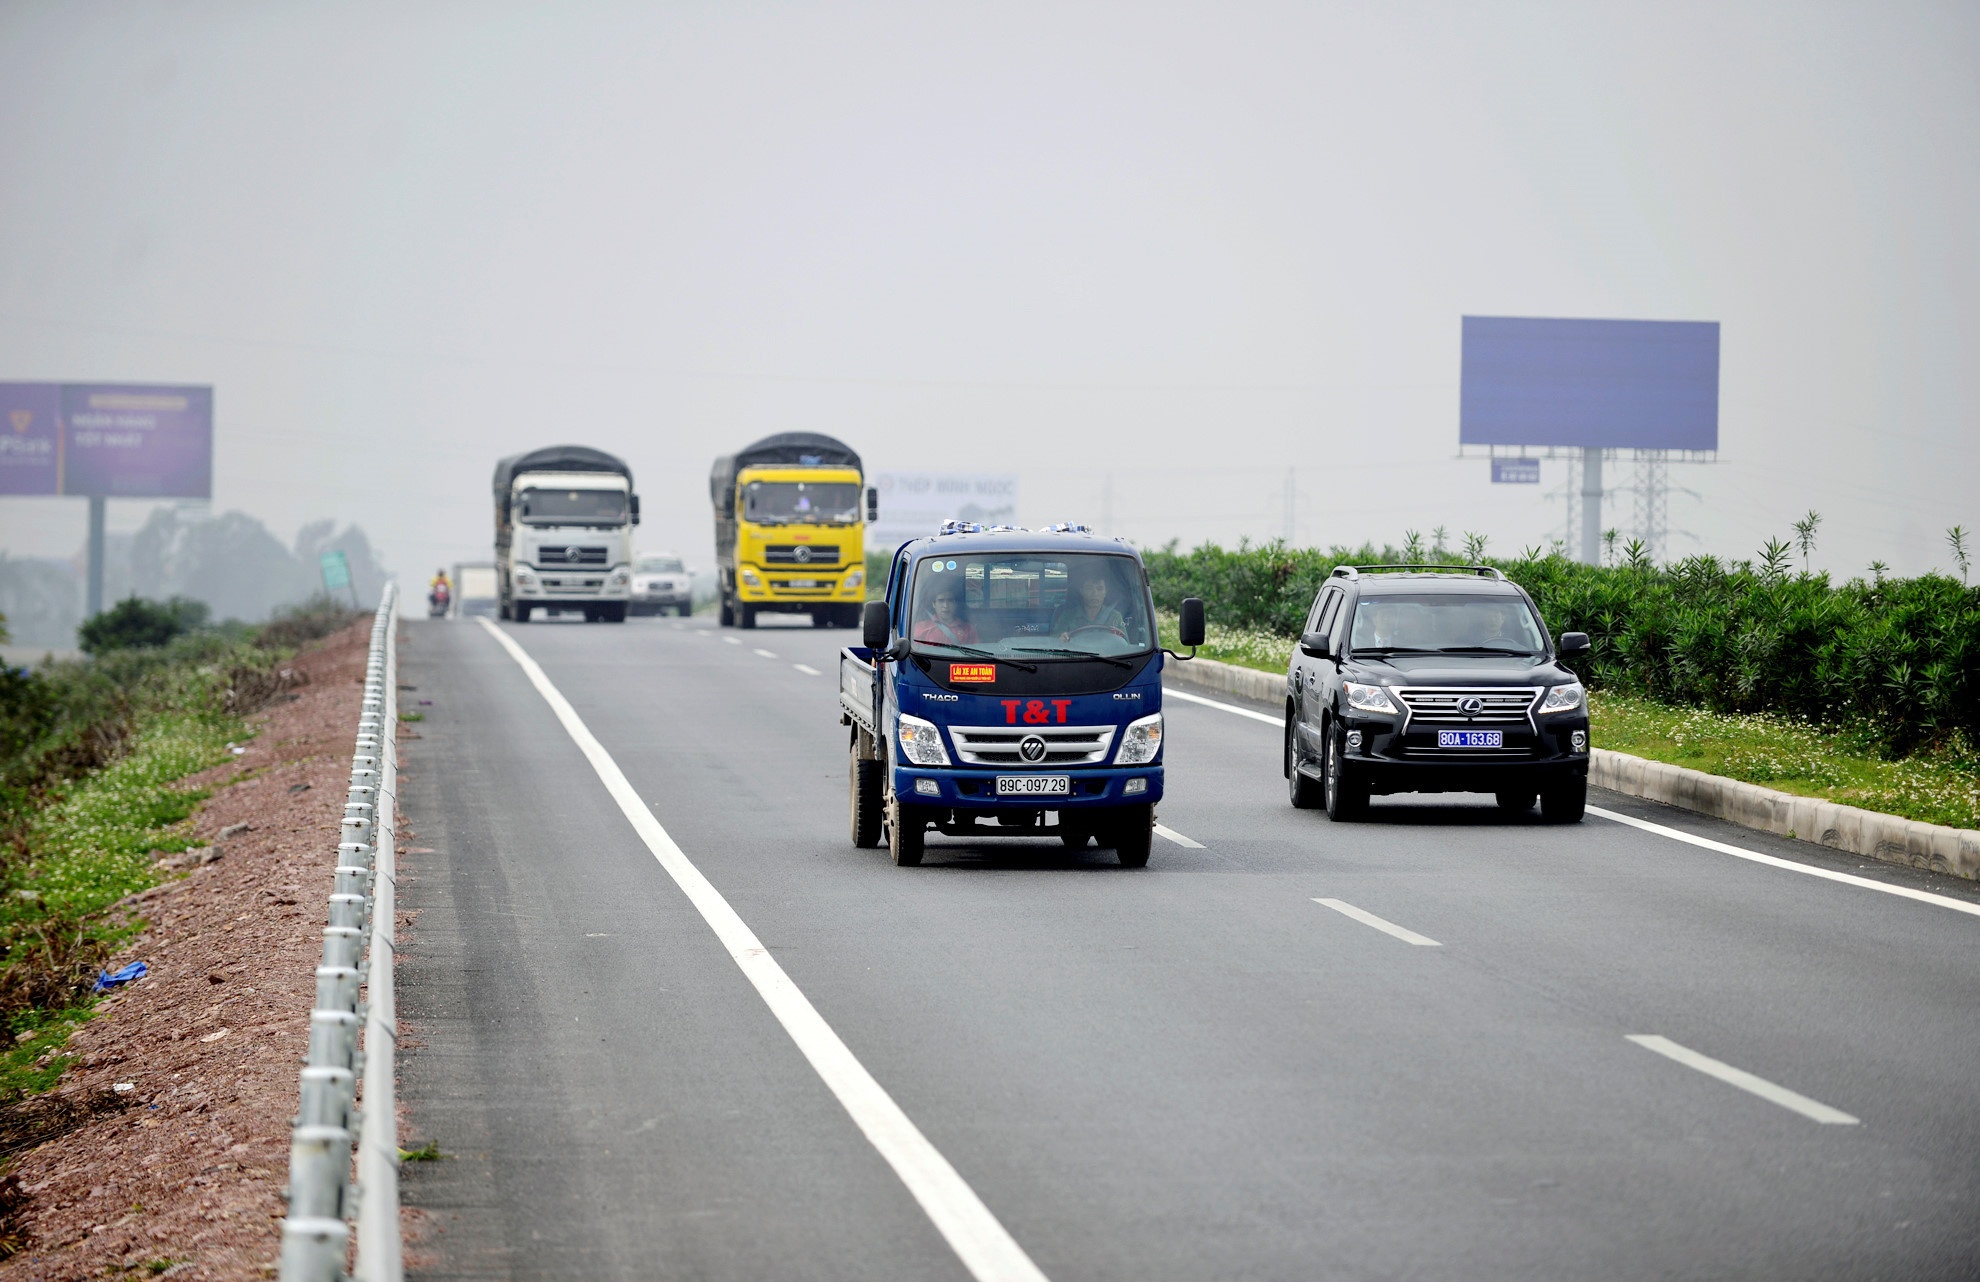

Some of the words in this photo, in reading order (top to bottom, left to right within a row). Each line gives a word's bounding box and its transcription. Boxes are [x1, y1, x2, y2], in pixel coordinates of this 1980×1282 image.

[953, 666, 962, 675] LÁI
[963, 667, 970, 675] XE
[970, 667, 978, 675] AN
[979, 666, 992, 675] TOÀN
[922, 693, 959, 702] THACO
[1112, 693, 1141, 701] OLLIN
[1001, 700, 1072, 724] T&T
[1440, 733, 1500, 745] 80A-163.68
[999, 779, 1067, 792] 89C-097.29
